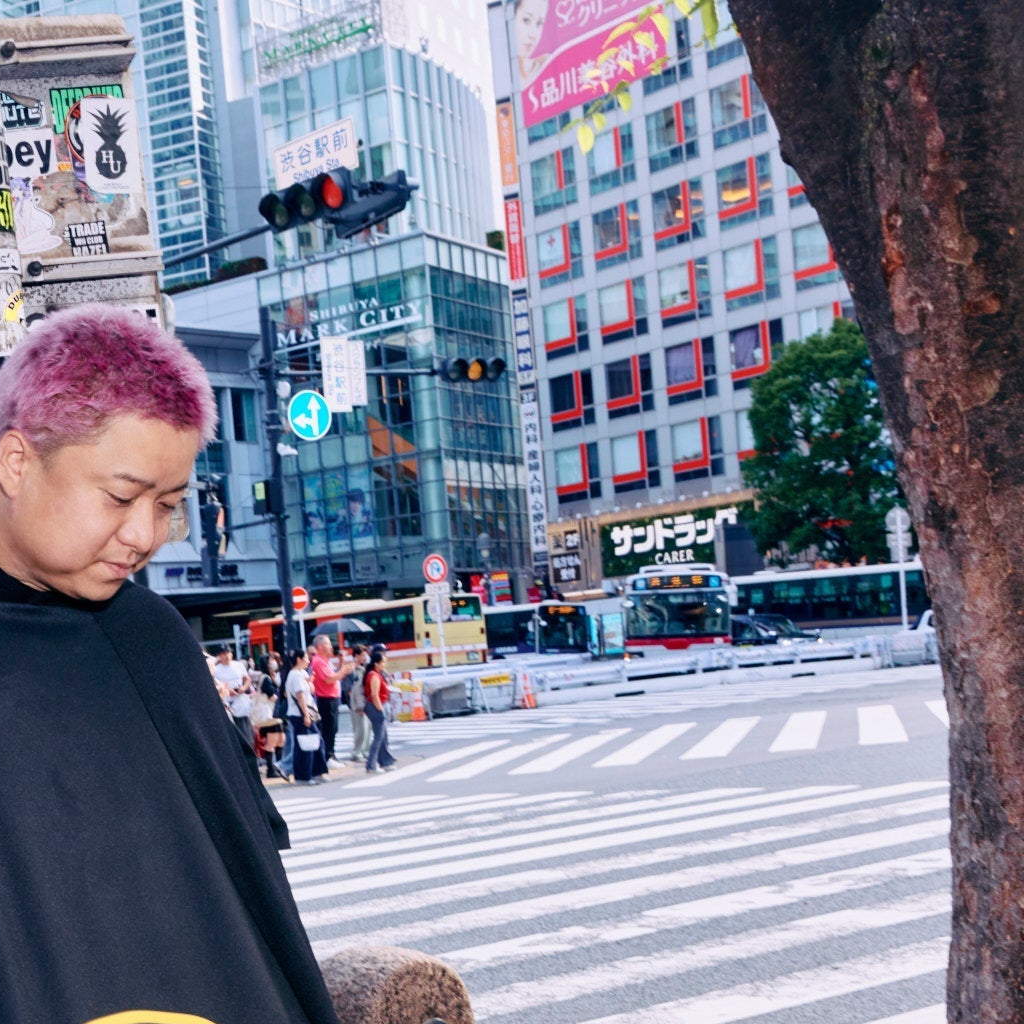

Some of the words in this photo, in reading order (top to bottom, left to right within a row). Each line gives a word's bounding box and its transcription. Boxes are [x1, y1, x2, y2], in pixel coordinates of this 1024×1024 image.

[280, 128, 348, 173] 渋谷駅前
[69, 221, 106, 238] TRADE
[309, 297, 379, 322] SHIBUYA
[277, 318, 348, 347] MARK
[359, 301, 422, 327] CITY
[655, 548, 694, 565] CARER
